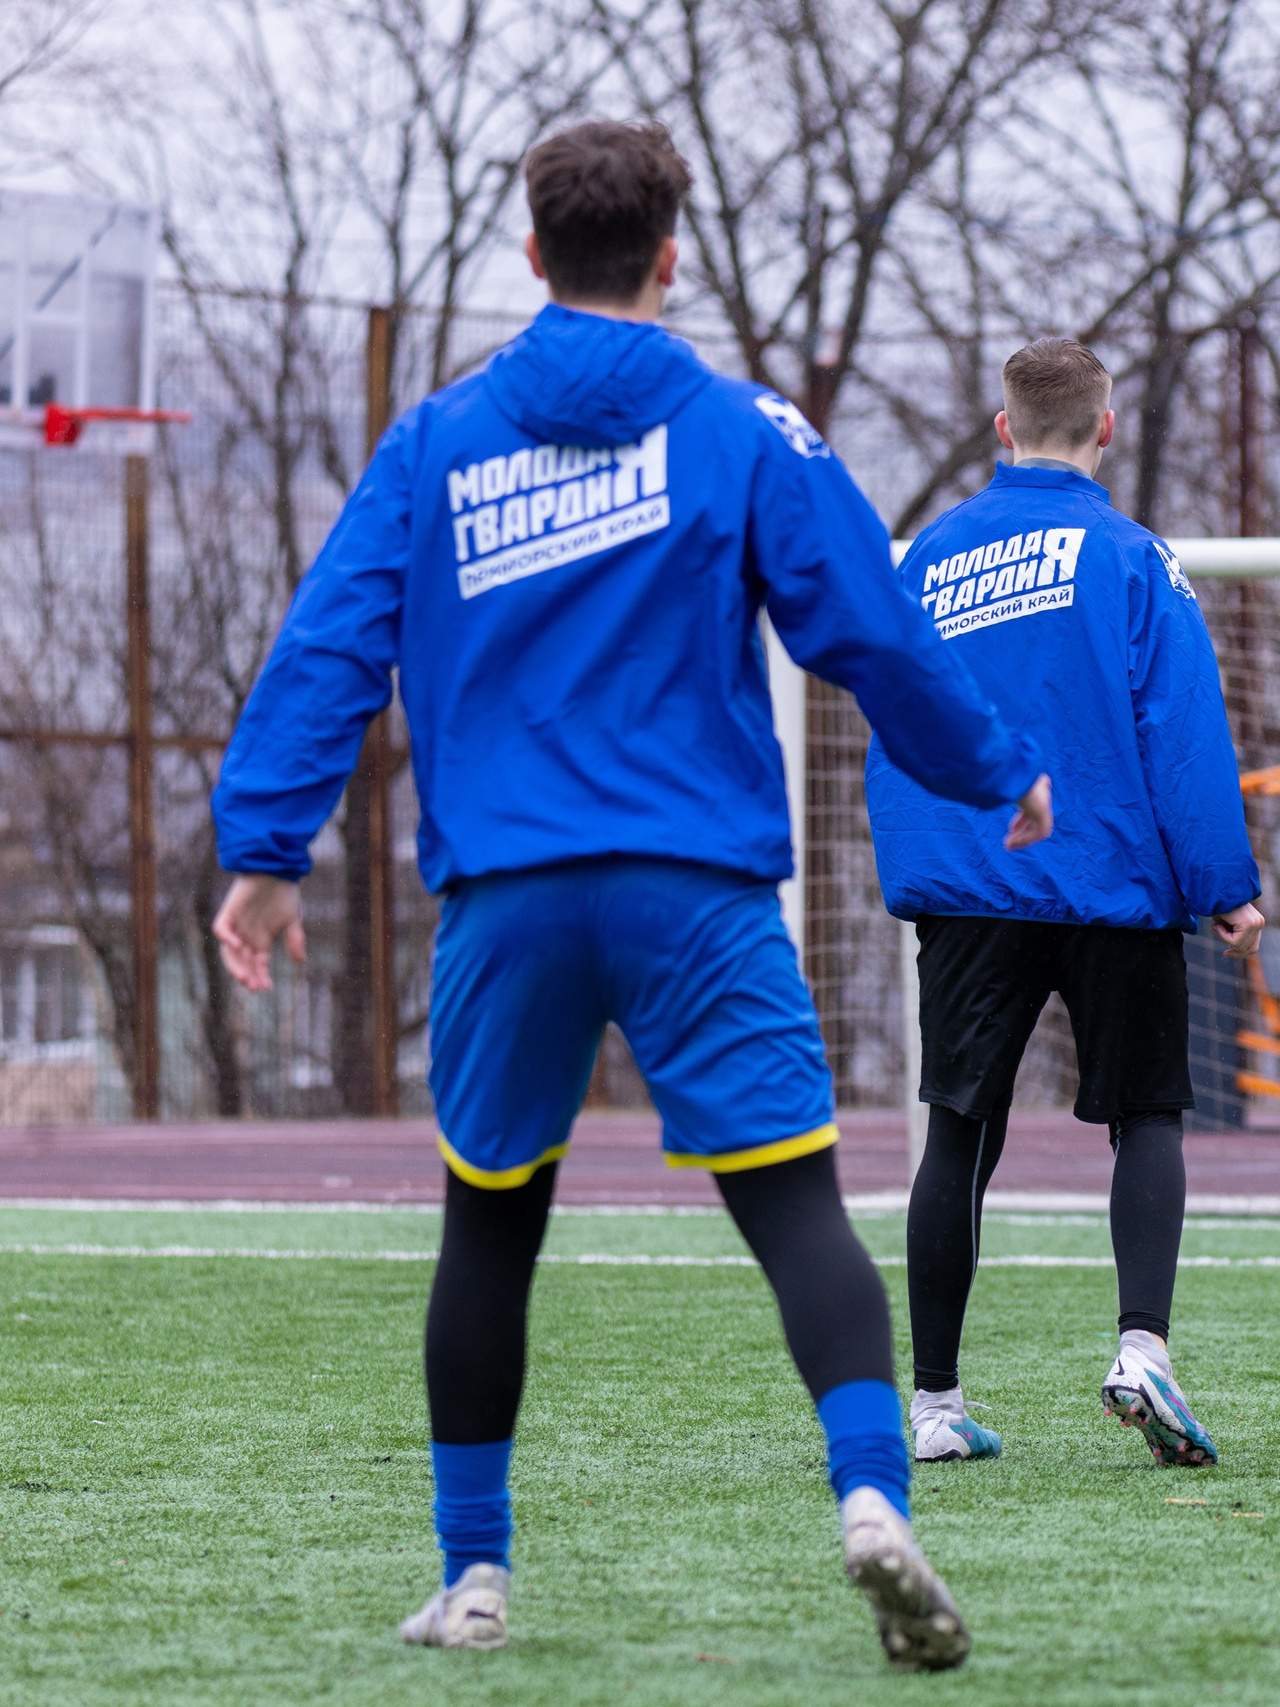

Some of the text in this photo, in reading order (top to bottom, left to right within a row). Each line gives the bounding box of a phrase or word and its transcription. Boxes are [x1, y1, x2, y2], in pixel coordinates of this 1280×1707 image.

[608, 504, 663, 536] КРАЙ
[938, 588, 1070, 636] ИМОРСКИЙ КРАЙ
